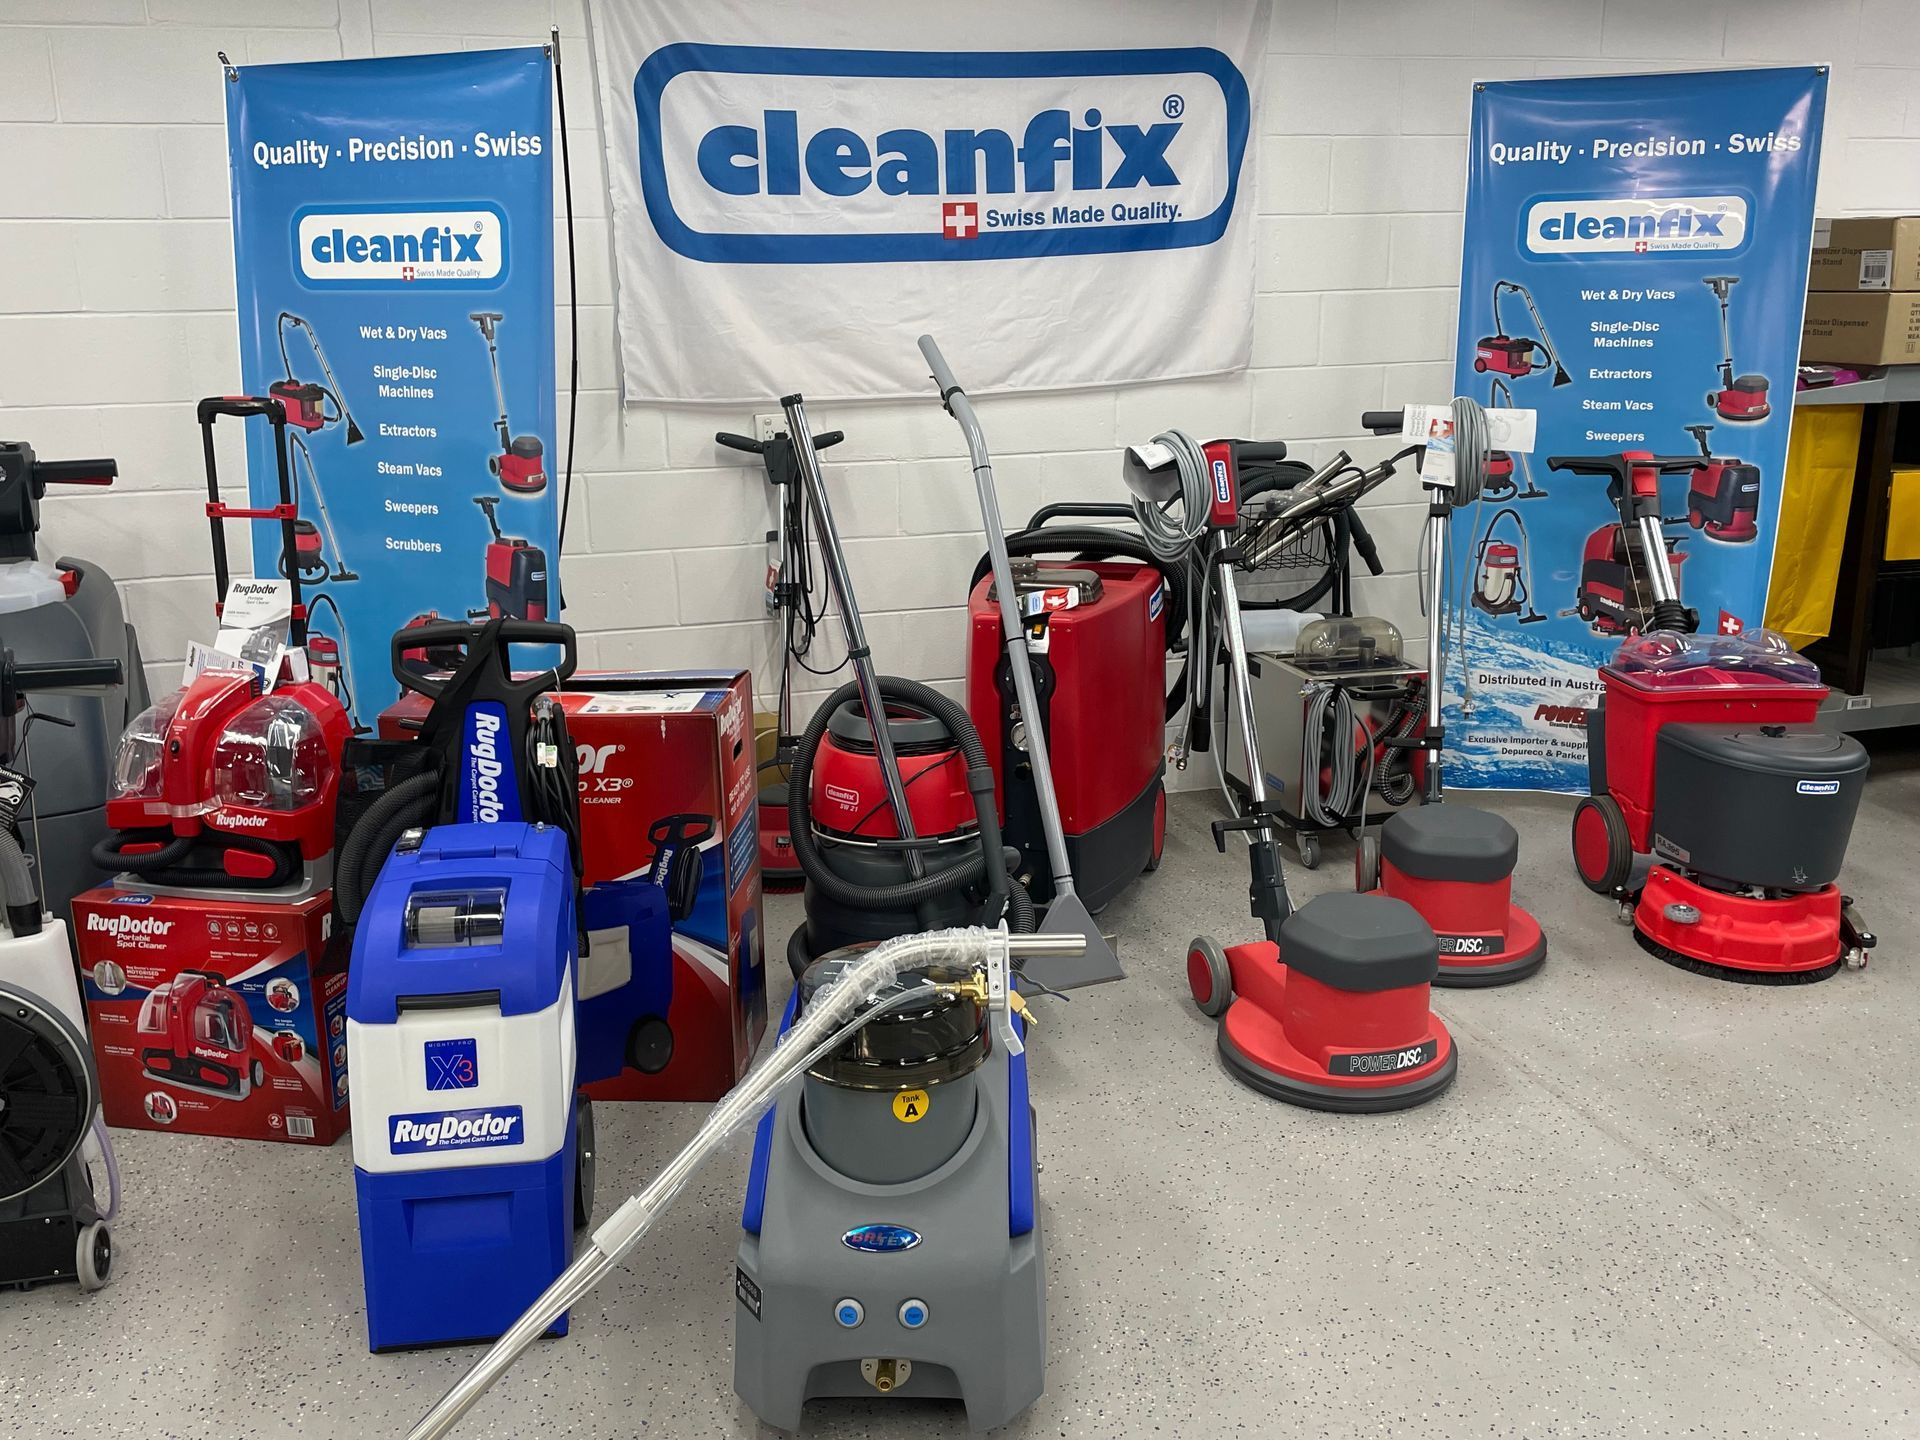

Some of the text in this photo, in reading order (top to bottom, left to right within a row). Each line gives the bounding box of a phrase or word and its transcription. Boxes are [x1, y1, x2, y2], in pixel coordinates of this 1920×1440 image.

[253, 140, 329, 169] Quality
[349, 135, 454, 162] Precision
[474, 131, 543, 157] Swiss
[1489, 141, 1572, 165] Quality
[1593, 137, 1706, 159] Precision
[1728, 132, 1801, 154] Swiss
[986, 202, 1183, 228] Swiss Made Quality.
[1649, 242, 1670, 250] Swiss
[1671, 241, 1692, 250] Made
[416, 268, 435, 278] Swiss
[435, 268, 455, 278] Made
[1581, 289, 1676, 302] Wet & Dry Vacs
[360, 326, 448, 342] Wet & Dry Vacs
[1590, 321, 1660, 334] Single-Disc
[1594, 337, 1654, 348] Machines
[373, 365, 437, 381] Single-Disc
[1589, 368, 1653, 379] Extractors
[378, 384, 434, 399] Machines
[1582, 400, 1654, 411] Steam Vacs
[379, 423, 437, 438] Extractors
[1585, 430, 1645, 443] Sweepers
[377, 461, 443, 477] Steam Vacs
[384, 500, 439, 515] Sweepers
[385, 537, 442, 553] Scrubbers
[1478, 674, 1607, 691] Distributed in Austra
[1468, 735, 1508, 744] Exclusive
[1560, 740, 1588, 750] suppli
[1501, 747, 1543, 758] Depureco
[1555, 751, 1587, 761] Parker
[0, 766, 25, 782] umatic
[471, 712, 504, 823] RugDocto
[1800, 784, 1836, 792] cleanfix
[216, 813, 268, 828] RugDoctor
[655, 849, 673, 889] RugDoc
[87, 912, 173, 937] RugDoctor
[117, 932, 151, 942] Portable
[116, 940, 167, 950] Spot Cleaner
[430, 1054, 474, 1091] X3
[901, 1094, 921, 1103] Tank
[904, 1104, 918, 1117] A
[393, 1113, 517, 1146] RugDoctor
[450, 1137, 471, 1145] Carpet
[486, 1134, 509, 1142] Experts
